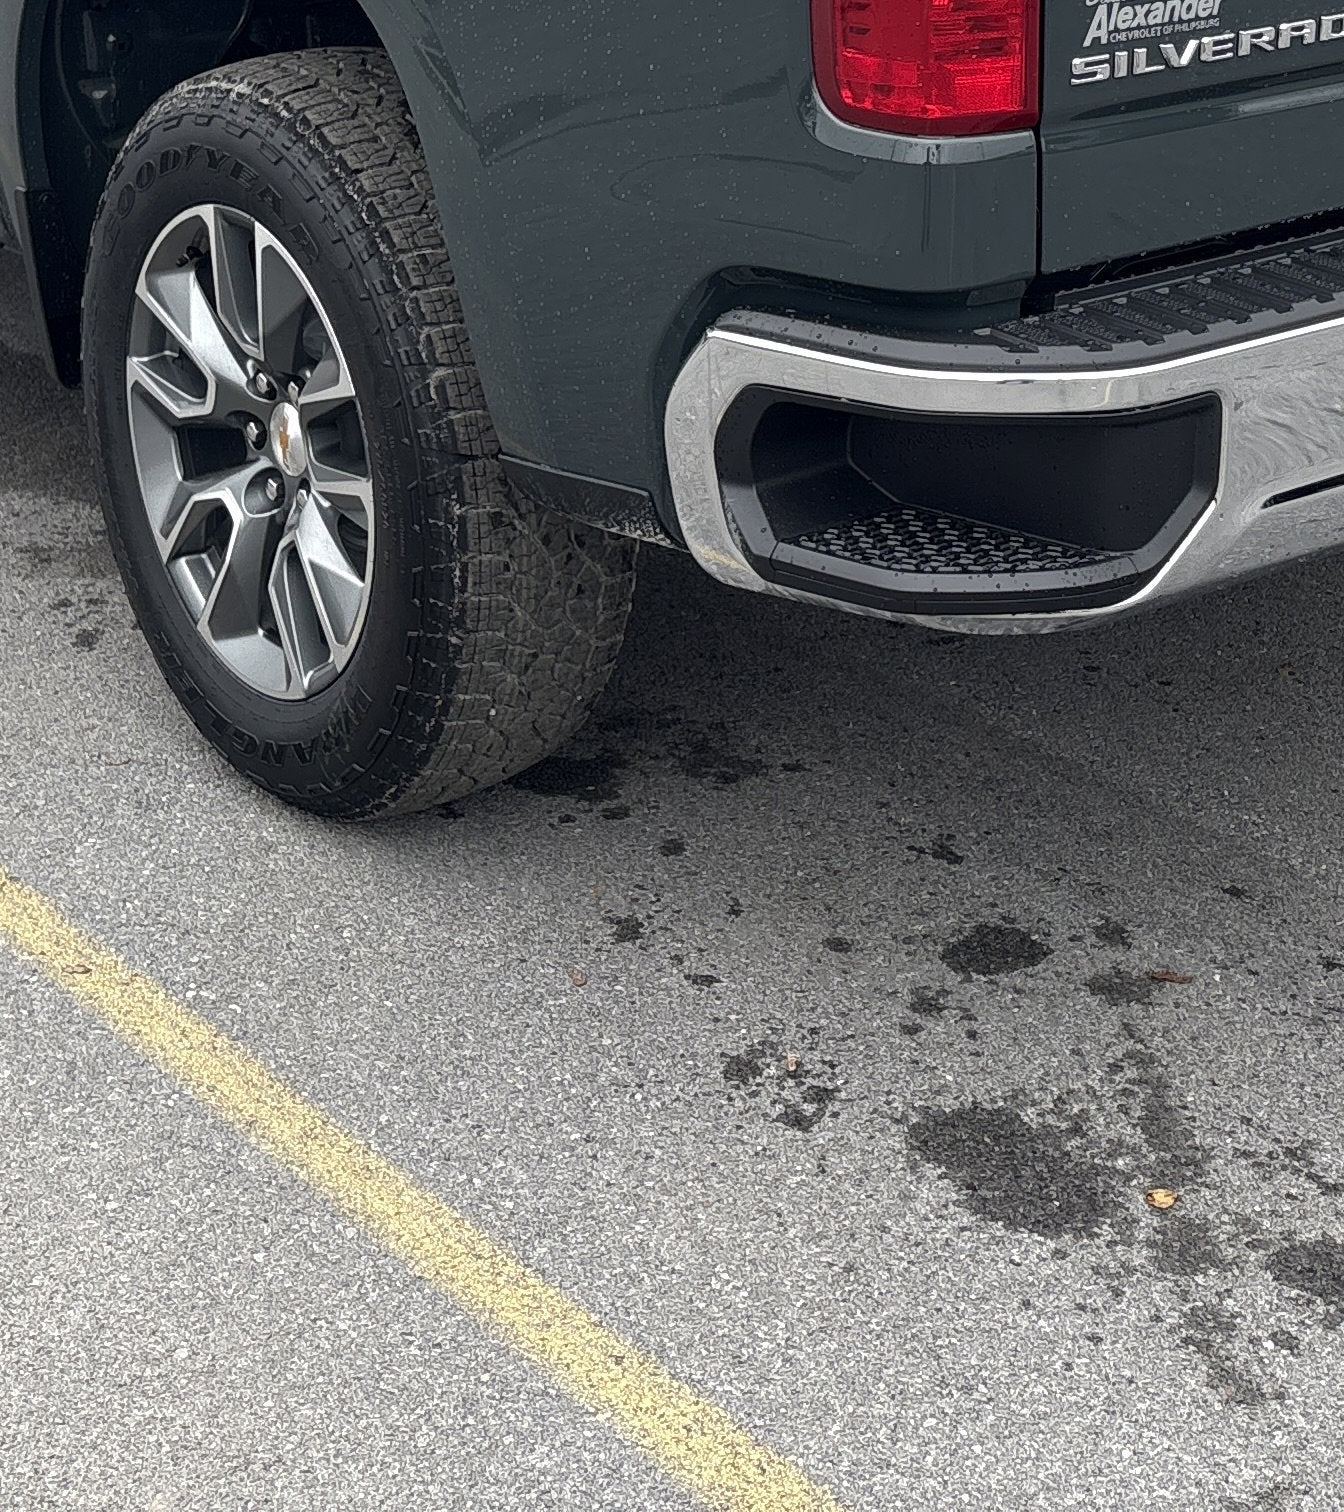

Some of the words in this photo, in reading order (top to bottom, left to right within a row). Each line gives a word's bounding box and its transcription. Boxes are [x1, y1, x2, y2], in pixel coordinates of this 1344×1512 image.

[1109, 27, 1162, 43] CHEVROLET
[1162, 25, 1174, 35] OF
[103, 141, 322, 266] GOODYEAR
